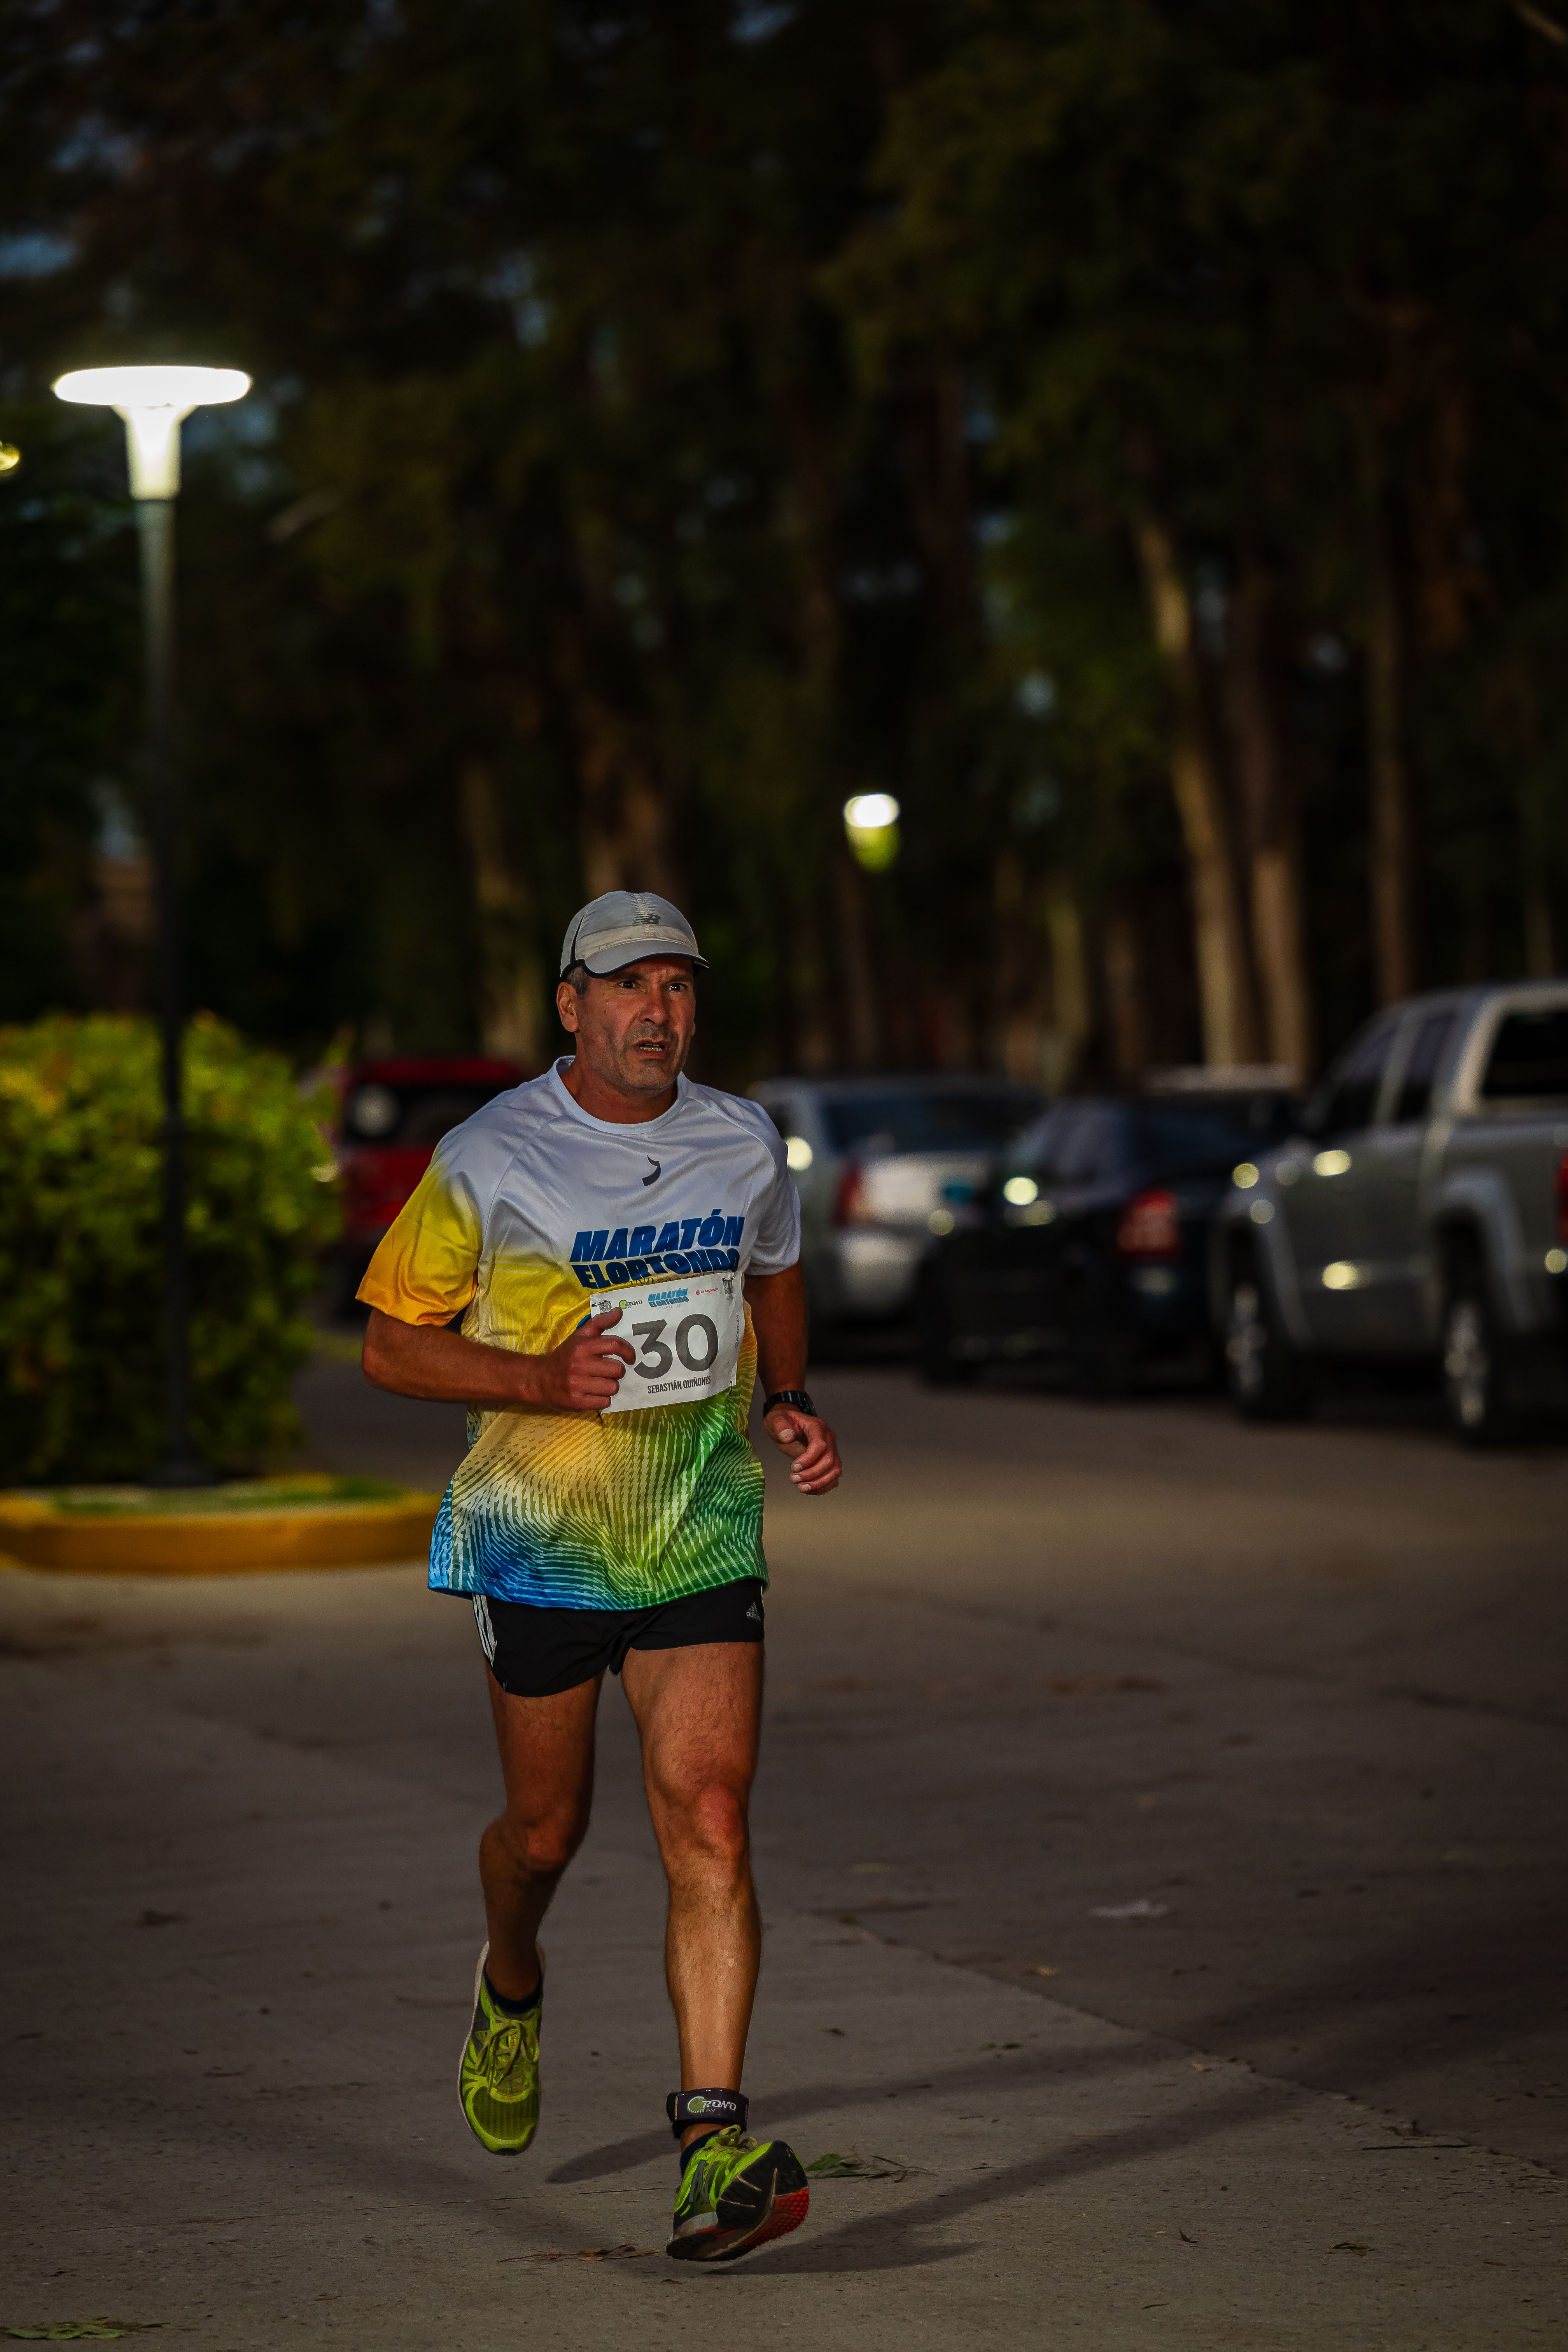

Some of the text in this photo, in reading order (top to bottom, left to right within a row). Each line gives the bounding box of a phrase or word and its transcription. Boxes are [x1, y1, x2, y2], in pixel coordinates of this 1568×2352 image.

[569, 1208, 745, 1262] MARATÓN
[571, 1248, 740, 1289] ELORTONDO
[648, 1287, 688, 1302] MARATÓN
[648, 1296, 689, 1307] ELORTONDO
[632, 1313, 719, 1379] 30
[648, 1377, 711, 1394] SEBASTIÁN QUIÑONES
